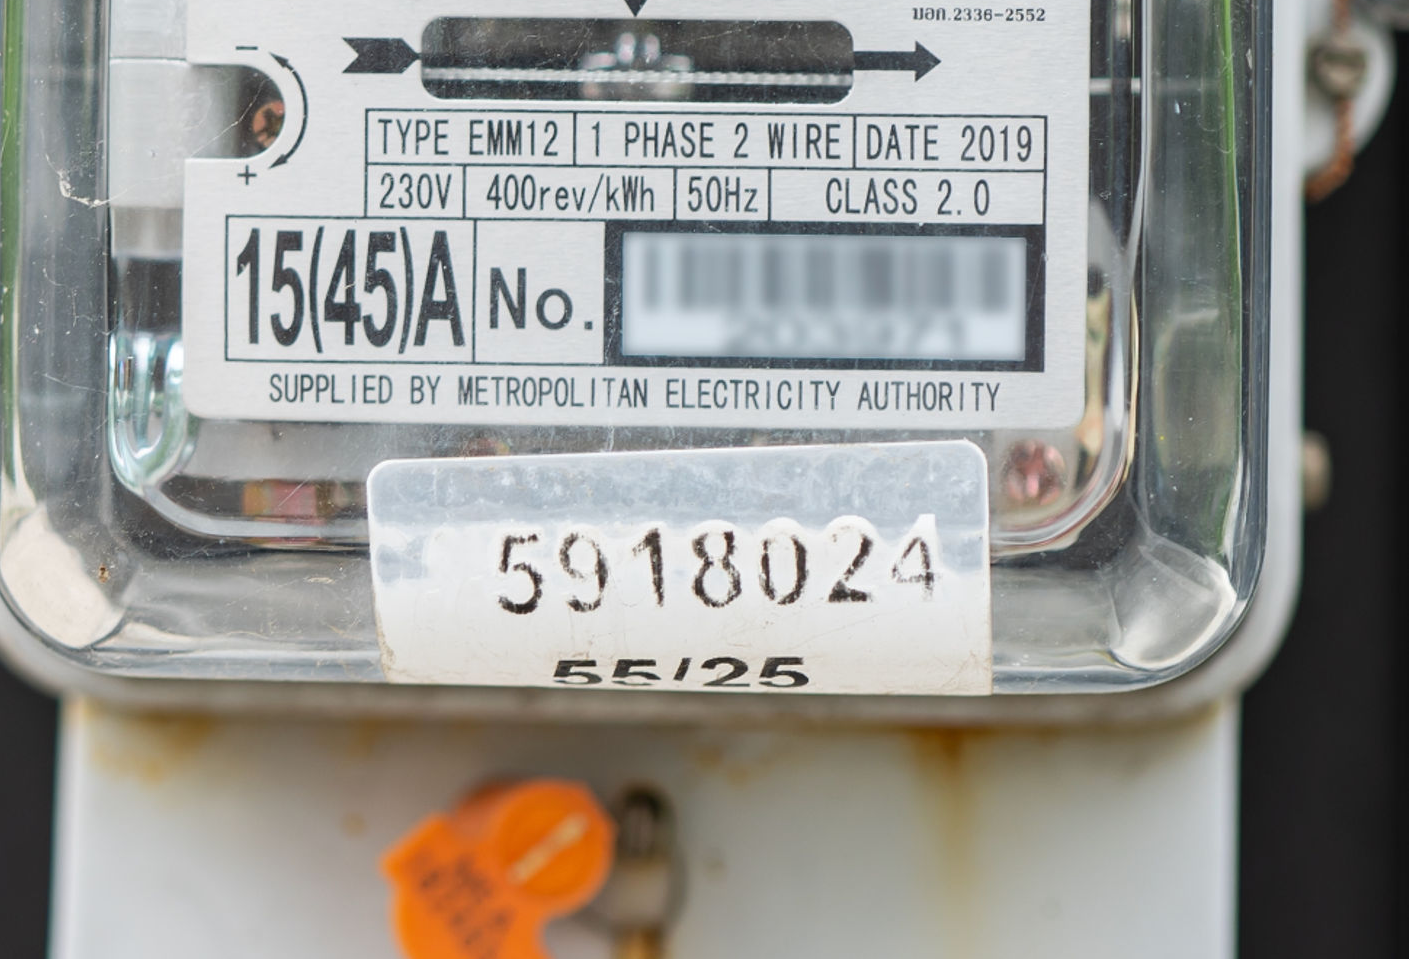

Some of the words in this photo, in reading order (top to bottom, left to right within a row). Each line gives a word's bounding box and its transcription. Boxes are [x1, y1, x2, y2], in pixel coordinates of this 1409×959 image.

[377, 118, 449, 156] TYPE
[468, 119, 559, 157] EMM12
[591, 121, 600, 157] 1
[624, 121, 715, 159] PHASE
[733, 122, 749, 159] 2
[767, 122, 841, 160] WIRE
[866, 123, 939, 161] DATE
[960, 124, 1032, 163] 2019
[379, 172, 452, 210] 230V
[486, 173, 655, 213] 400rev/kWh
[687, 175, 758, 213] 50Hz
[825, 177, 918, 215] CLASS
[937, 178, 990, 216] 2.0
[236, 226, 465, 355] 15(45)A
[489, 267, 593, 331] No.
[269, 373, 393, 404] SUPPLIED
[410, 375, 441, 405] BY
[458, 376, 648, 408] METROPOLITAN
[666, 378, 841, 410] ELECTRICITY
[857, 381, 1000, 412] AUTHORITY
[496, 525, 936, 617] 5918024
